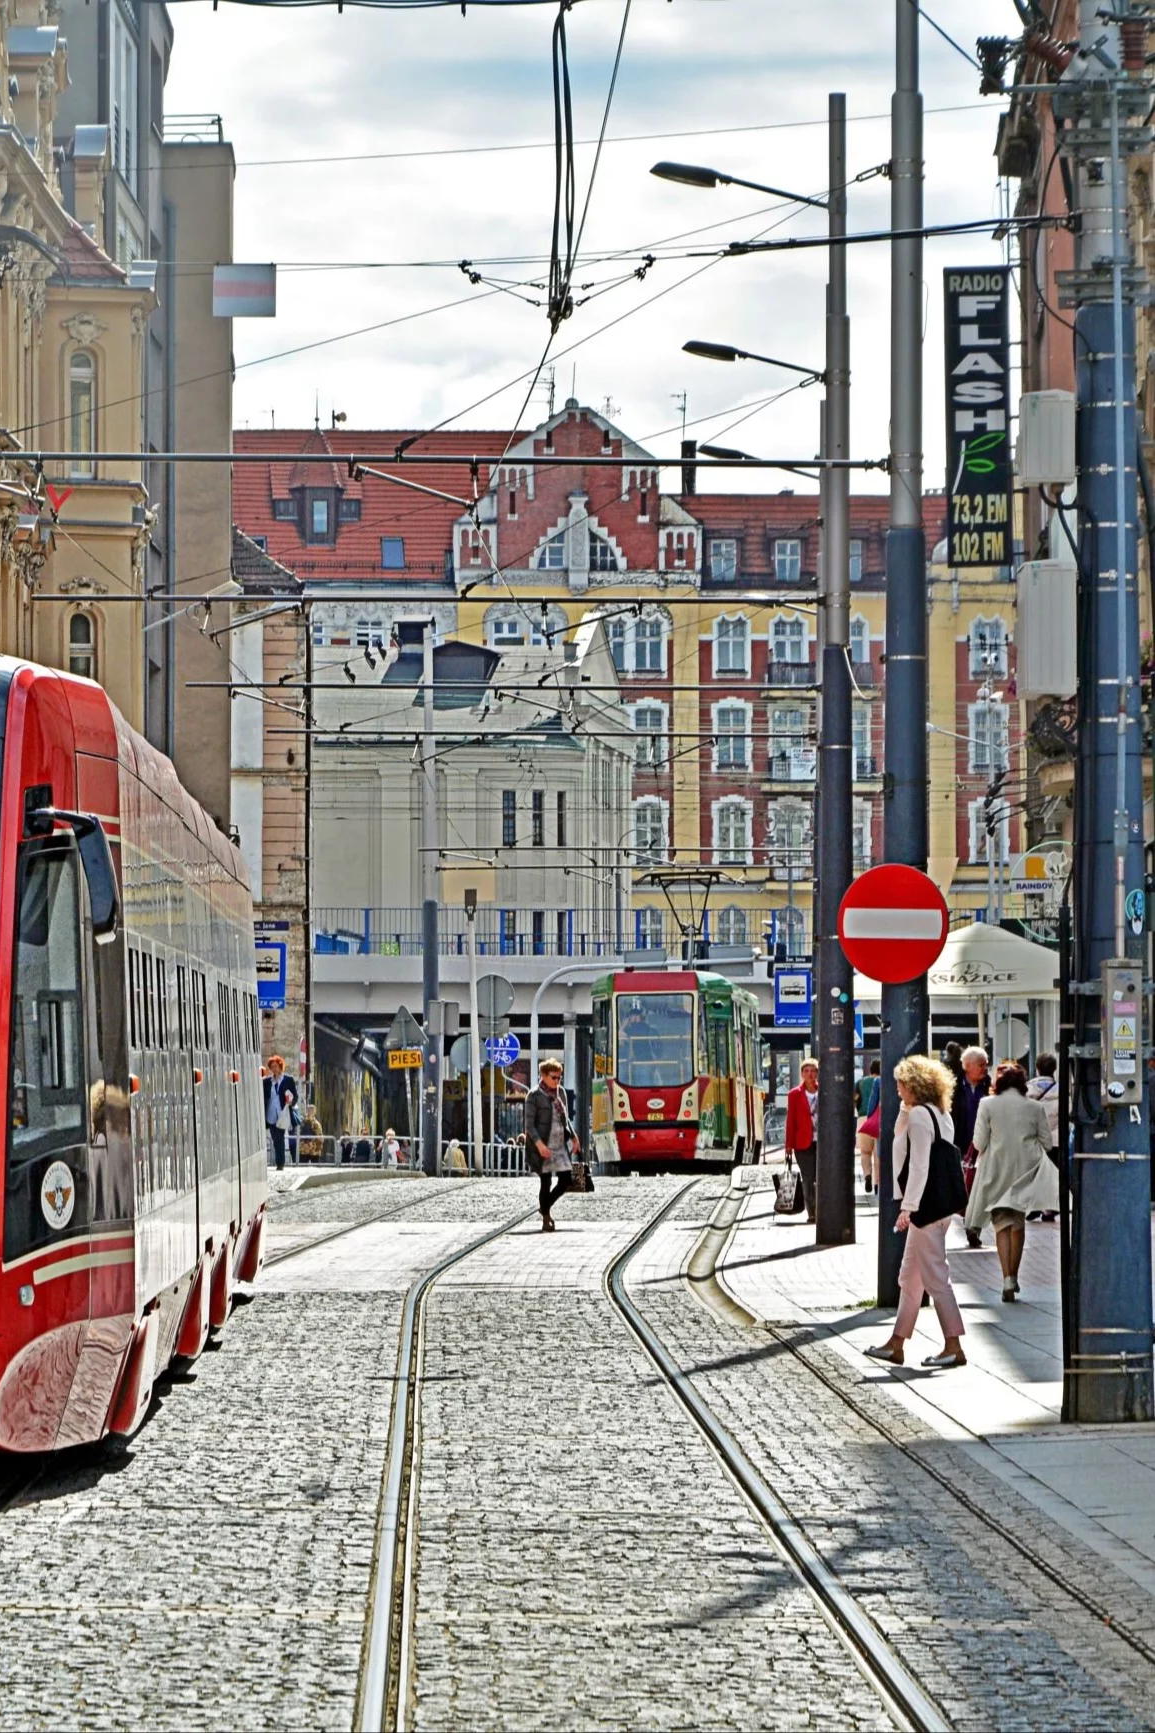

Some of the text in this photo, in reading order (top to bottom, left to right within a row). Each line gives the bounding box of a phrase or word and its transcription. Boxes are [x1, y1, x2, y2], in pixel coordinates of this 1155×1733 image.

[949, 274, 1004, 292] RADIO
[951, 295, 1006, 431] FLASH
[952, 493, 1007, 531] 73,2 FM
[953, 532, 1004, 562] 102 FM
[391, 1054, 422, 1064] PIESI
